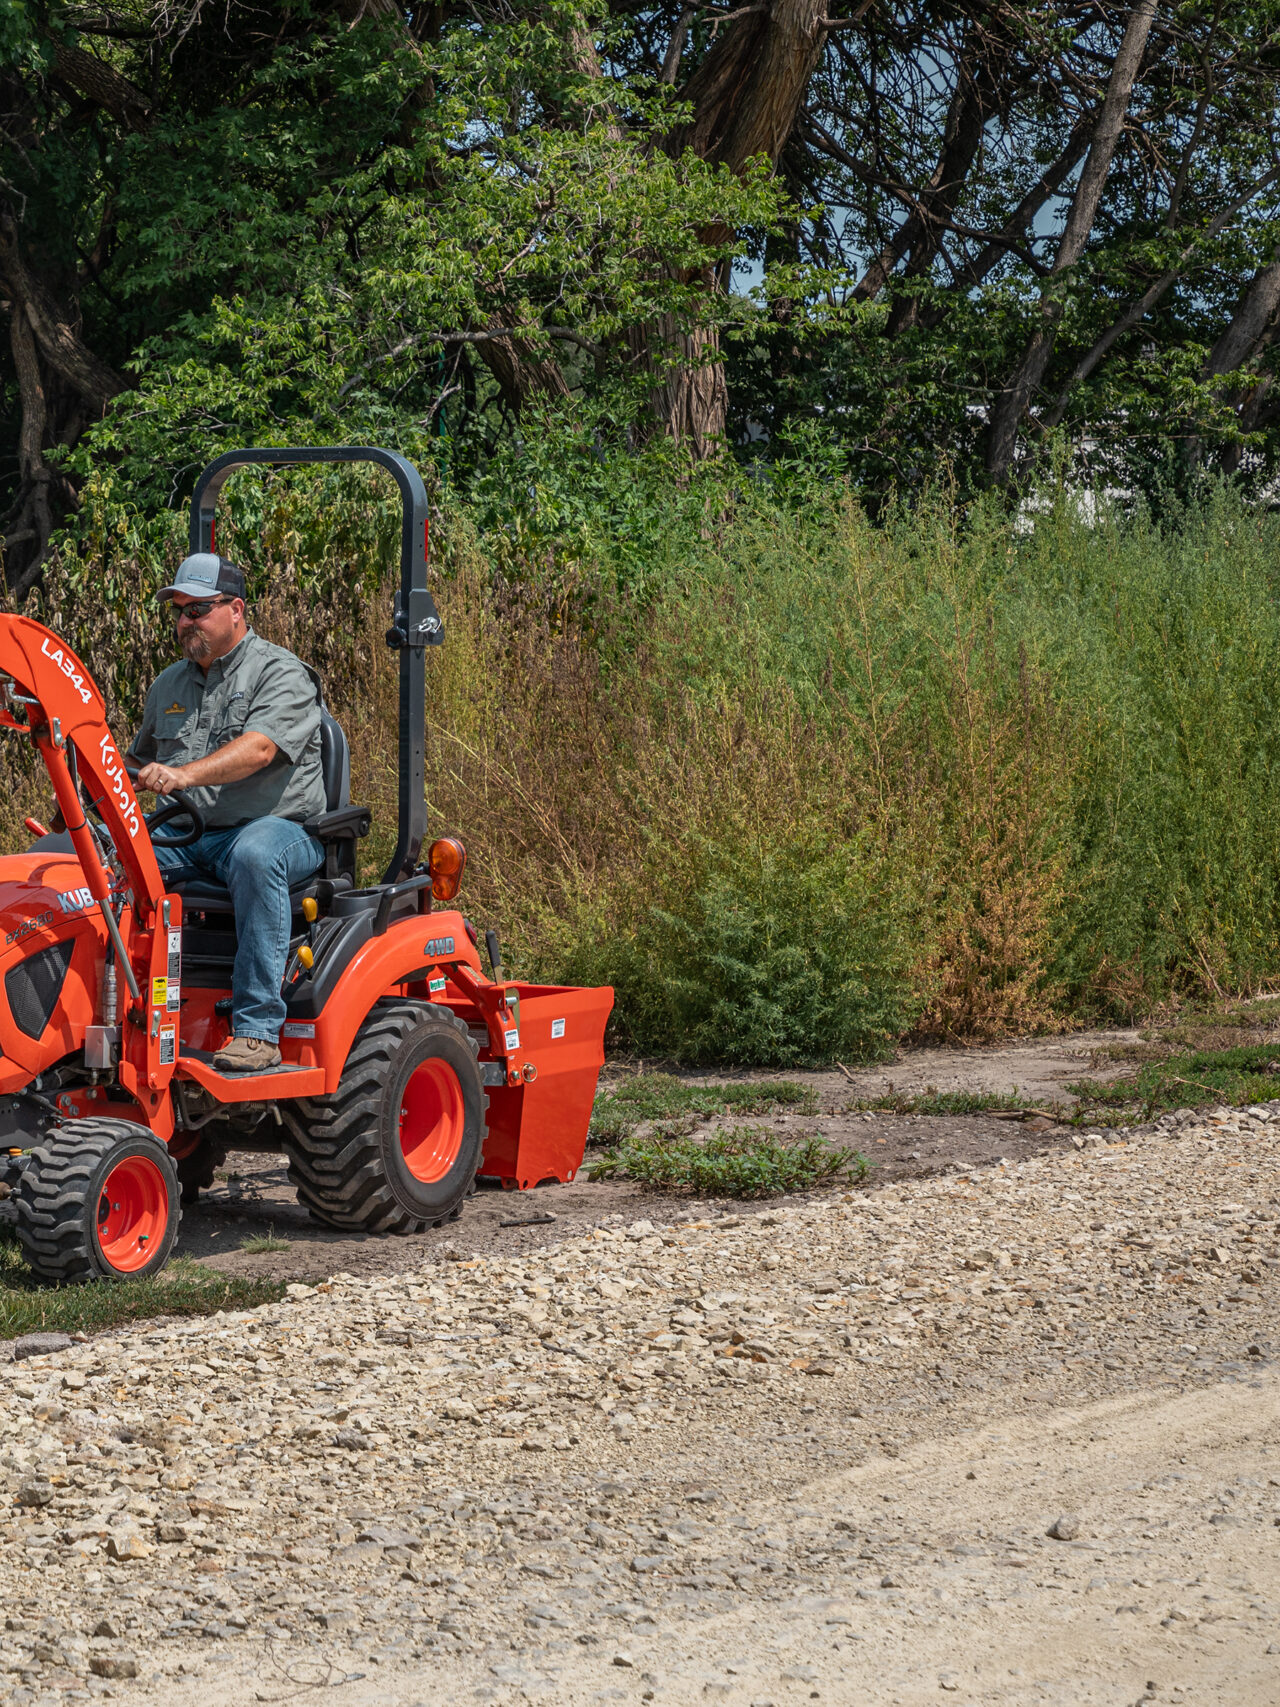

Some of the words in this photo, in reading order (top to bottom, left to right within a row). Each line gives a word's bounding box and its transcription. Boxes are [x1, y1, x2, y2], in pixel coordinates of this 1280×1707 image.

[41, 638, 93, 704] LA344
[99, 733, 140, 838] Kubota
[5, 911, 54, 945] BX2680
[424, 936, 455, 957] 4WD
